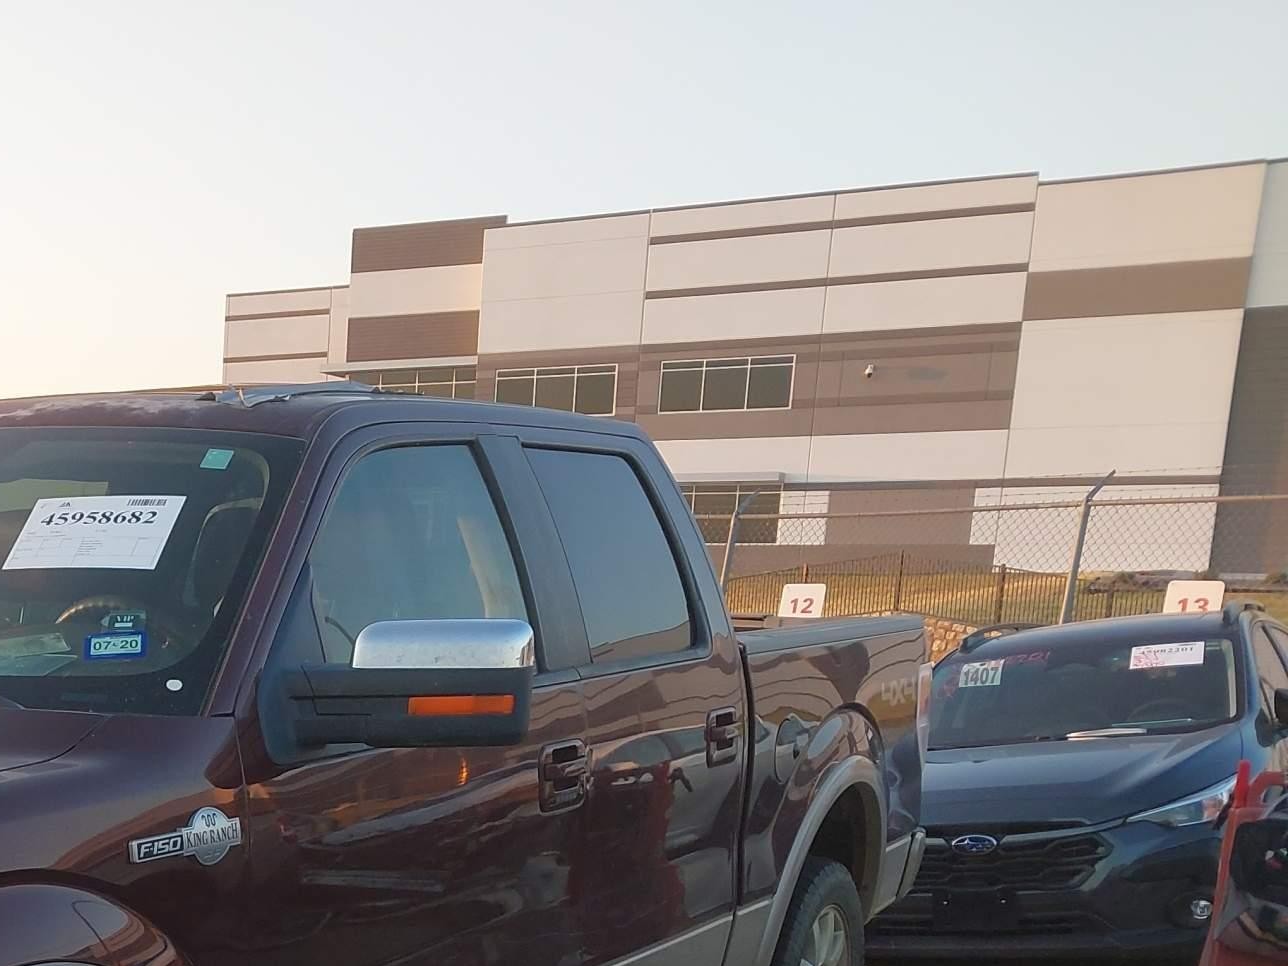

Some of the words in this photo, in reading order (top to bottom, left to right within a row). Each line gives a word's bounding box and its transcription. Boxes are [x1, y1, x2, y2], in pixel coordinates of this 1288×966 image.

[41, 511, 158, 526] 45958682
[790, 598, 814, 614] 12
[1178, 598, 1209, 613] 13
[93, 641, 111, 651] 07
[120, 640, 138, 649] 20
[963, 667, 999, 685] 1407
[186, 831, 209, 849] KING
[210, 823, 238, 844] RANCH
[140, 837, 182, 858] F-150
